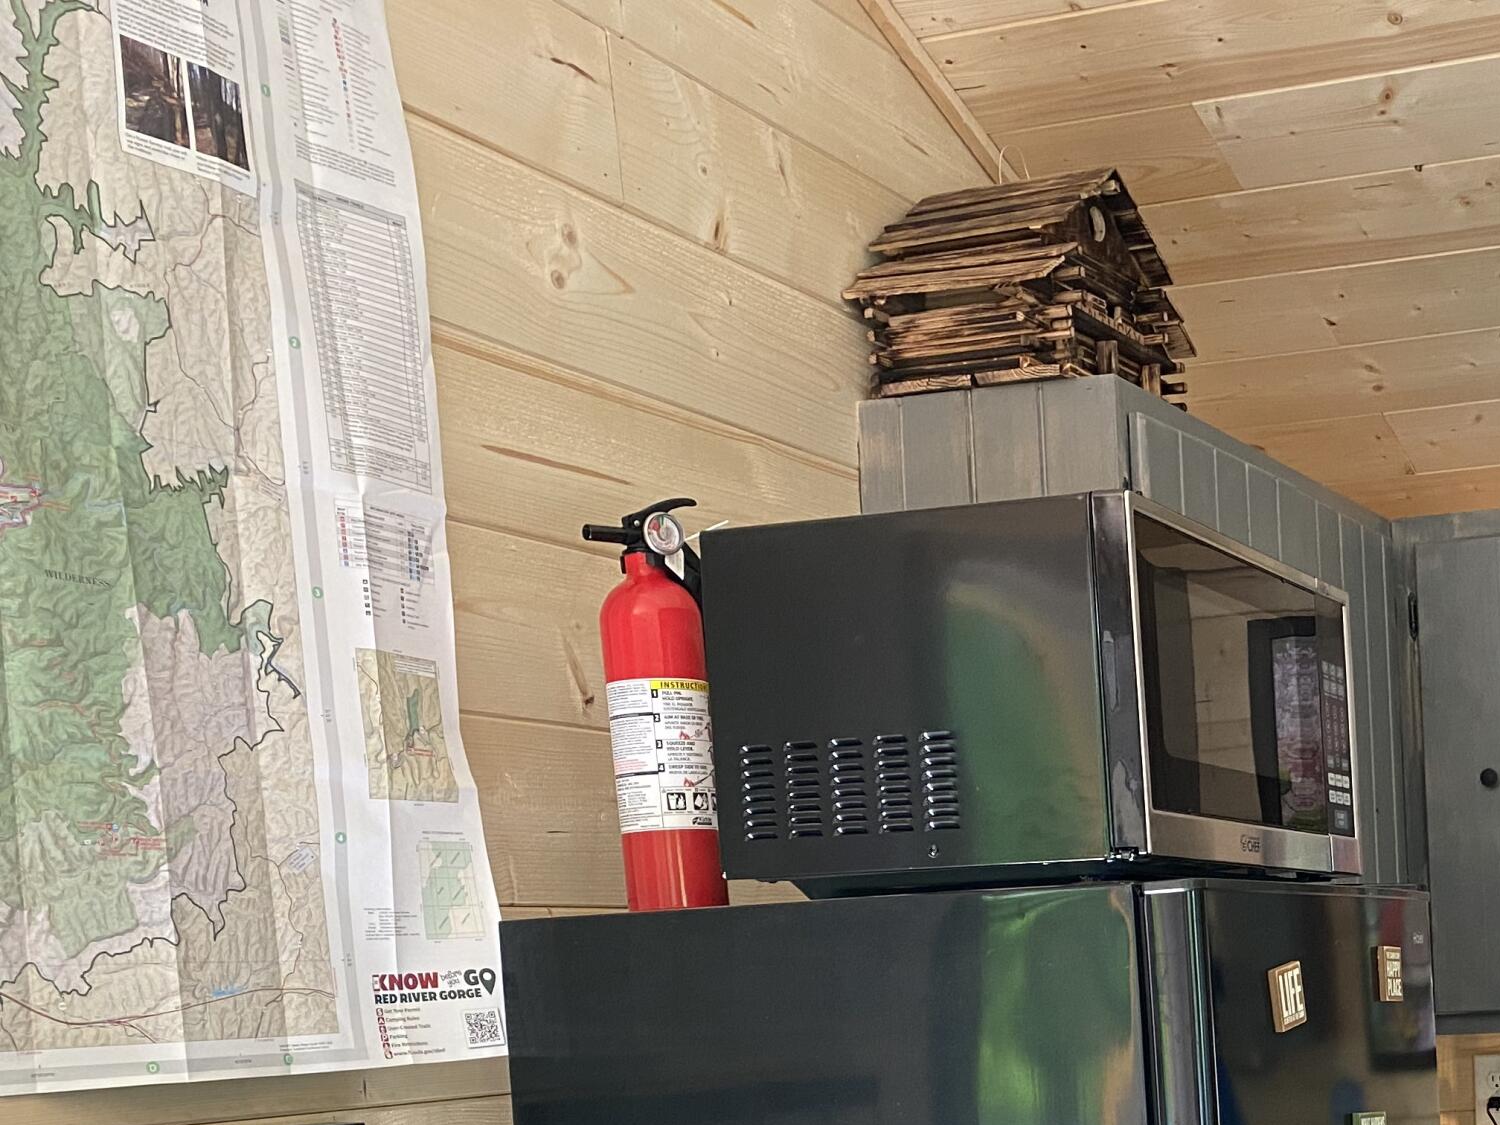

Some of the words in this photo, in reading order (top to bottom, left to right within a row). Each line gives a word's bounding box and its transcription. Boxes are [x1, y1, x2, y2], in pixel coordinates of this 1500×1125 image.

[373, 972, 439, 991] KNOW
[464, 968, 496, 995] GO
[1279, 968, 1304, 1017] LIFE
[375, 993, 398, 1005] RED
[400, 991, 437, 1003] RIVER
[439, 988, 482, 1000] GORGE
